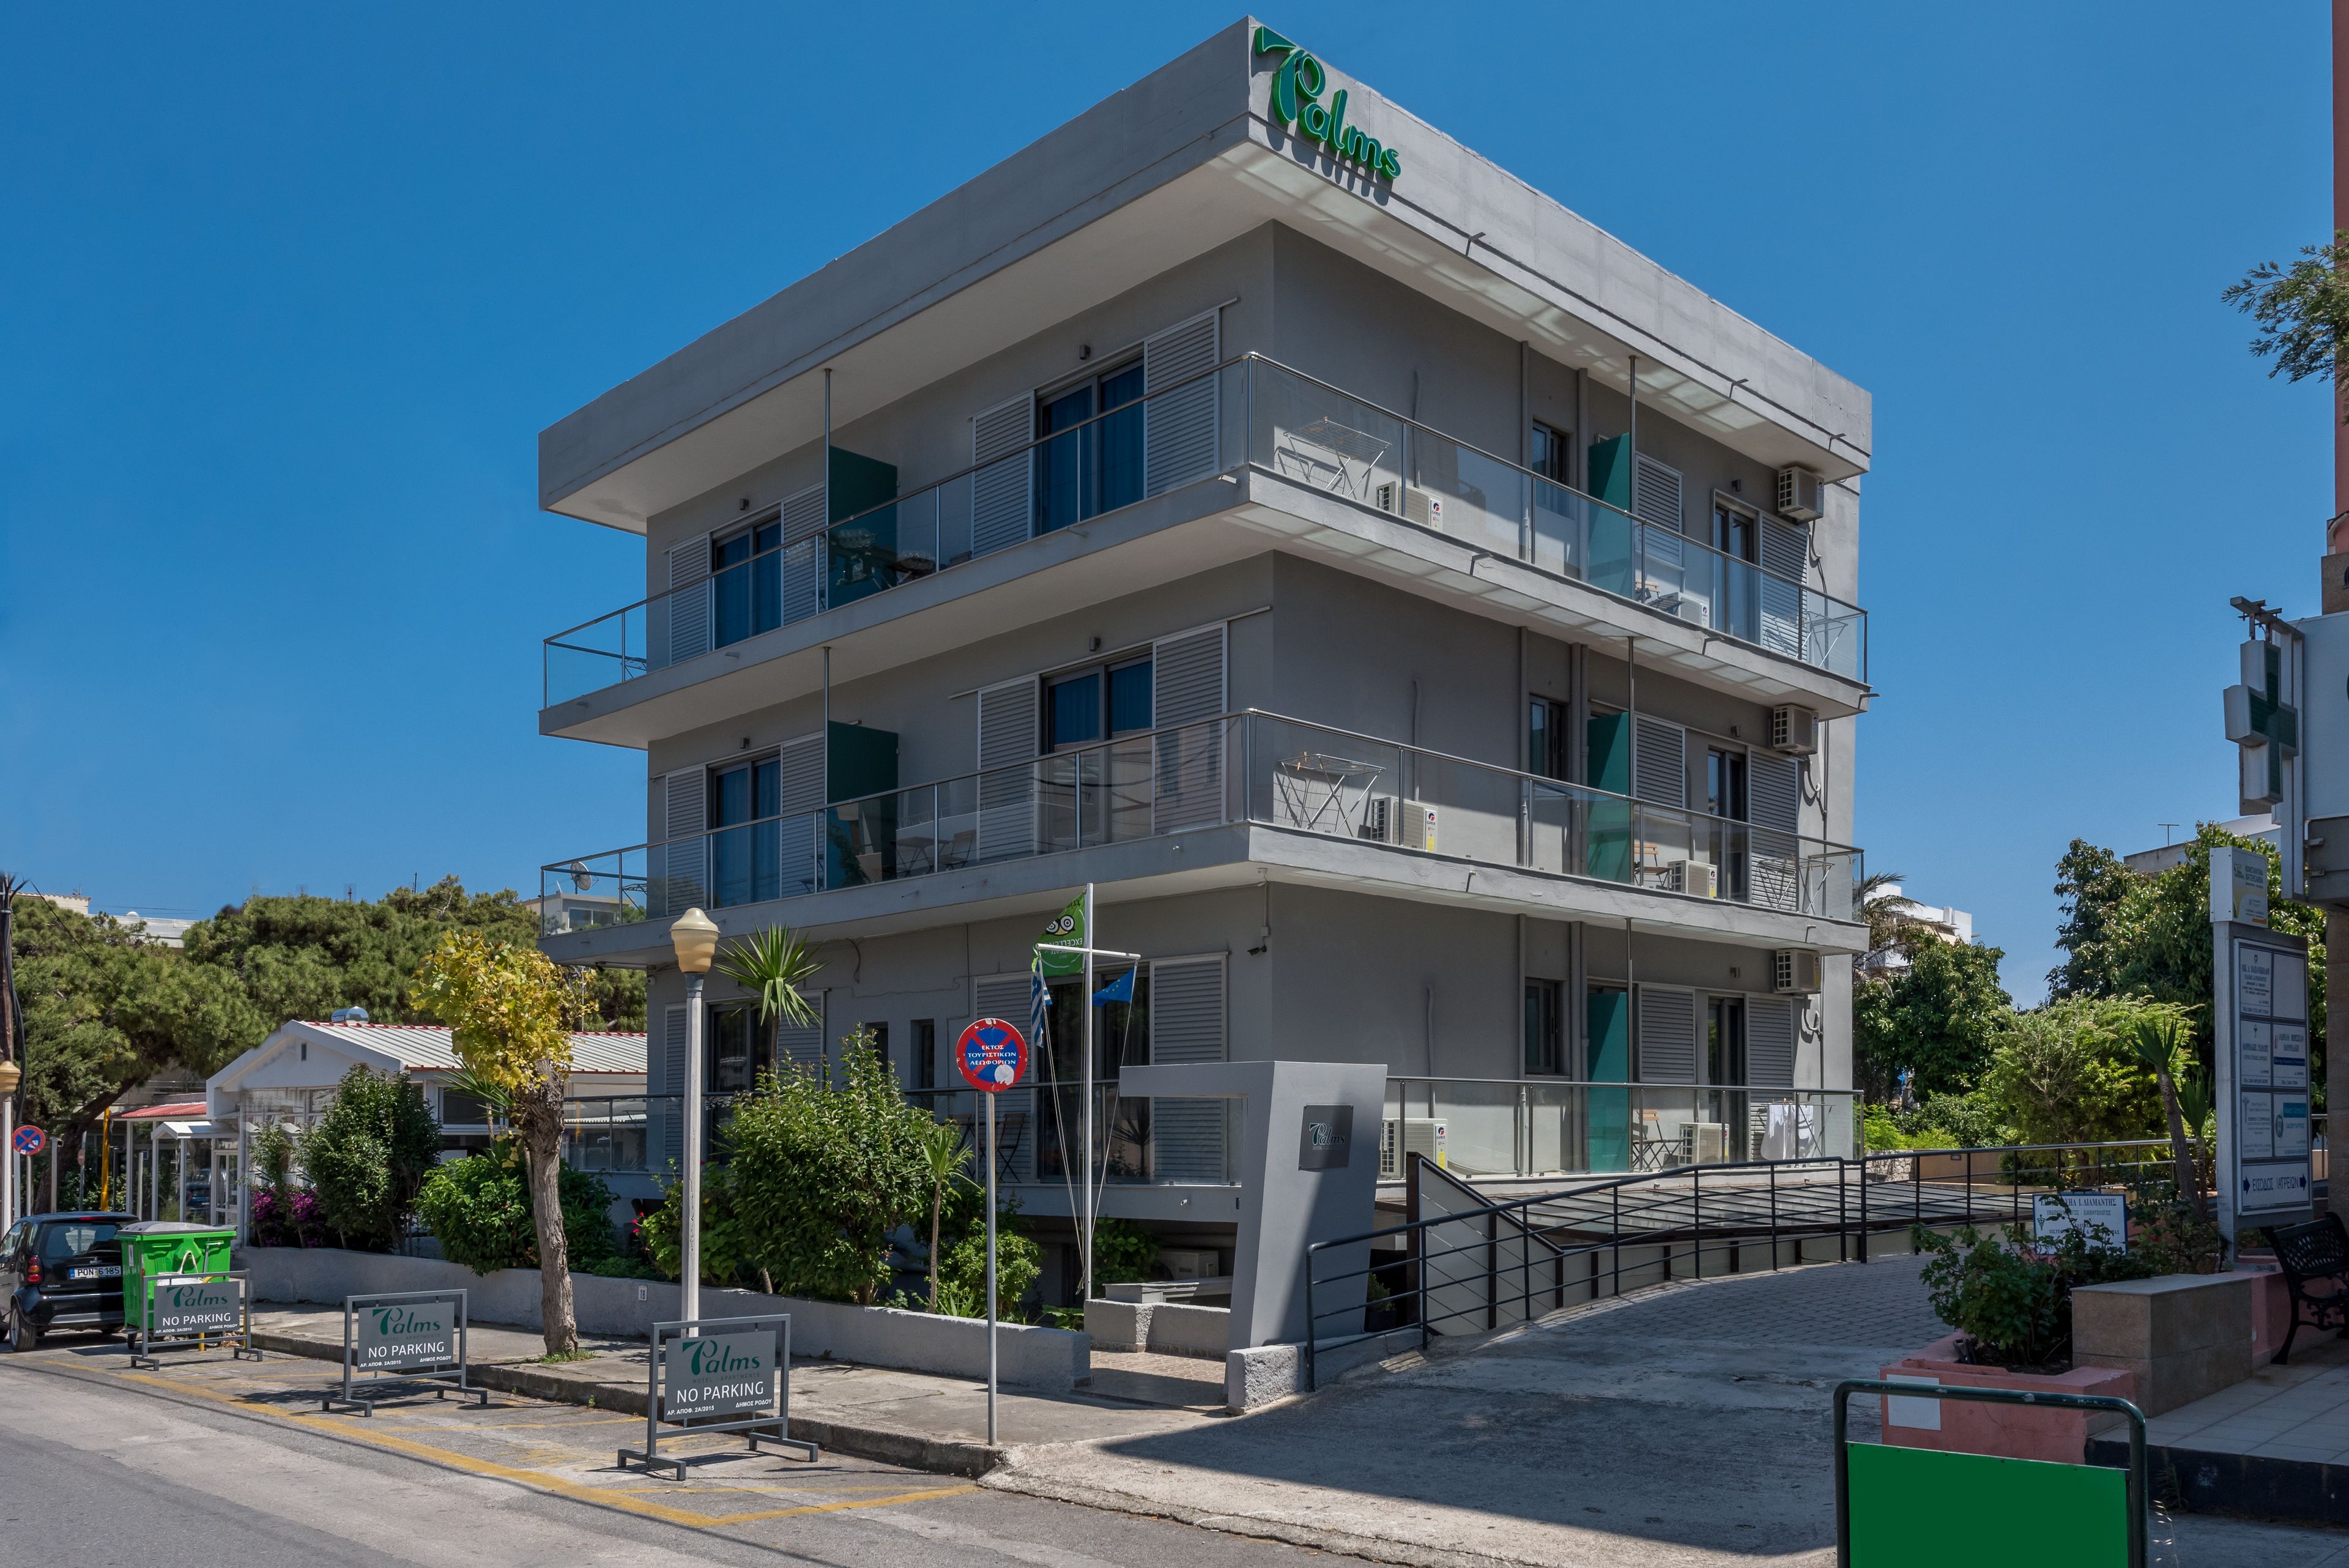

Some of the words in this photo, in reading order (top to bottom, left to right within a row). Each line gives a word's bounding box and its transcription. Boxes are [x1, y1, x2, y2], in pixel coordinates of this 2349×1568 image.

[2252, 1178, 2274, 1191] ΕΙΣΟΔΟΣ
[2276, 1176, 2299, 1189] ΙΑΤΡΕΙΩΝ
[163, 1317, 179, 1326] NO
[184, 1312, 231, 1325] PARKING
[368, 1346, 387, 1358] NO
[392, 1341, 444, 1356] PARKING
[677, 1388, 699, 1403] NO
[703, 1381, 763, 1400] PARKING
